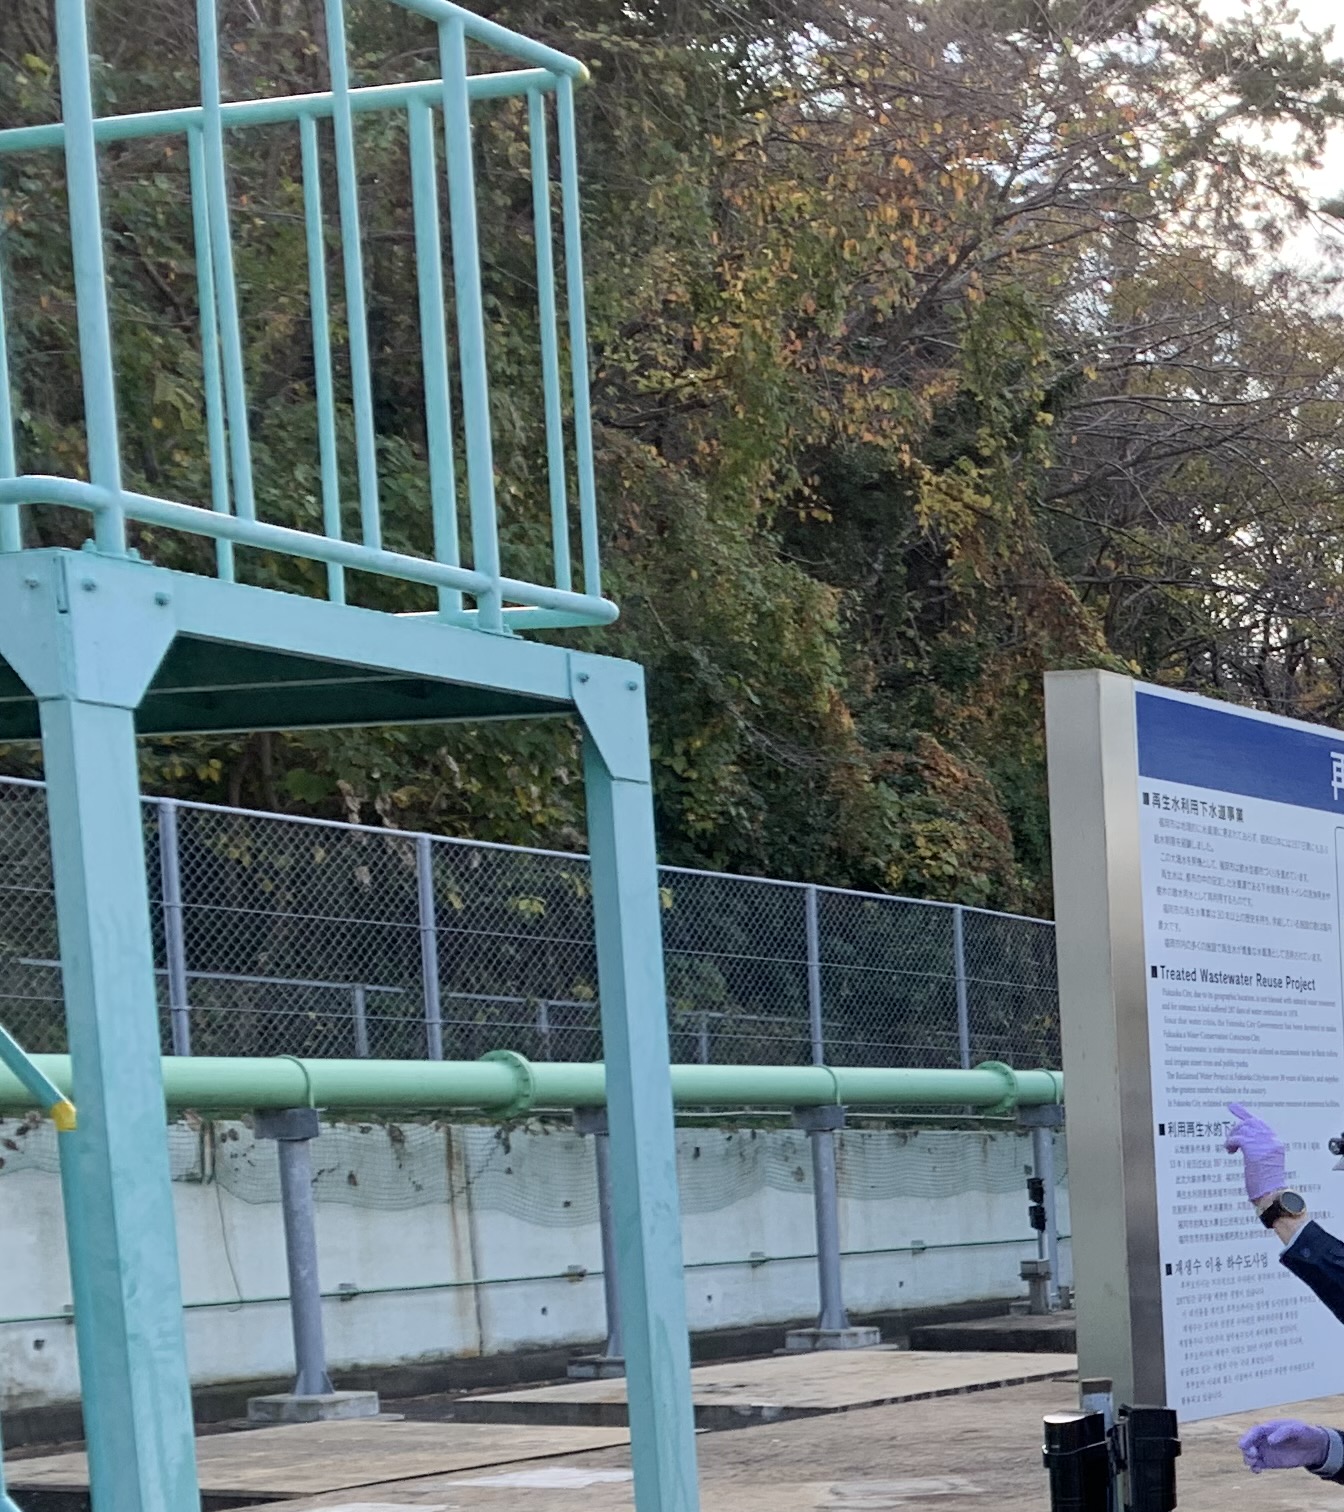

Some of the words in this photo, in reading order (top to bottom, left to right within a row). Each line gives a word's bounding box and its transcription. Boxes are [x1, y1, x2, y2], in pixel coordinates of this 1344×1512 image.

[1152, 792, 1245, 822] 再生水利用下水道事業
[1160, 965, 1197, 982] Treated
[1200, 968, 1253, 987] Wastewater
[1256, 973, 1283, 989] Reuse
[1286, 976, 1316, 993] Project
[1175, 1258, 1202, 1276] 재생수
[1205, 1255, 1223, 1272] 이용
[1226, 1252, 1268, 1271] 하수도사업
